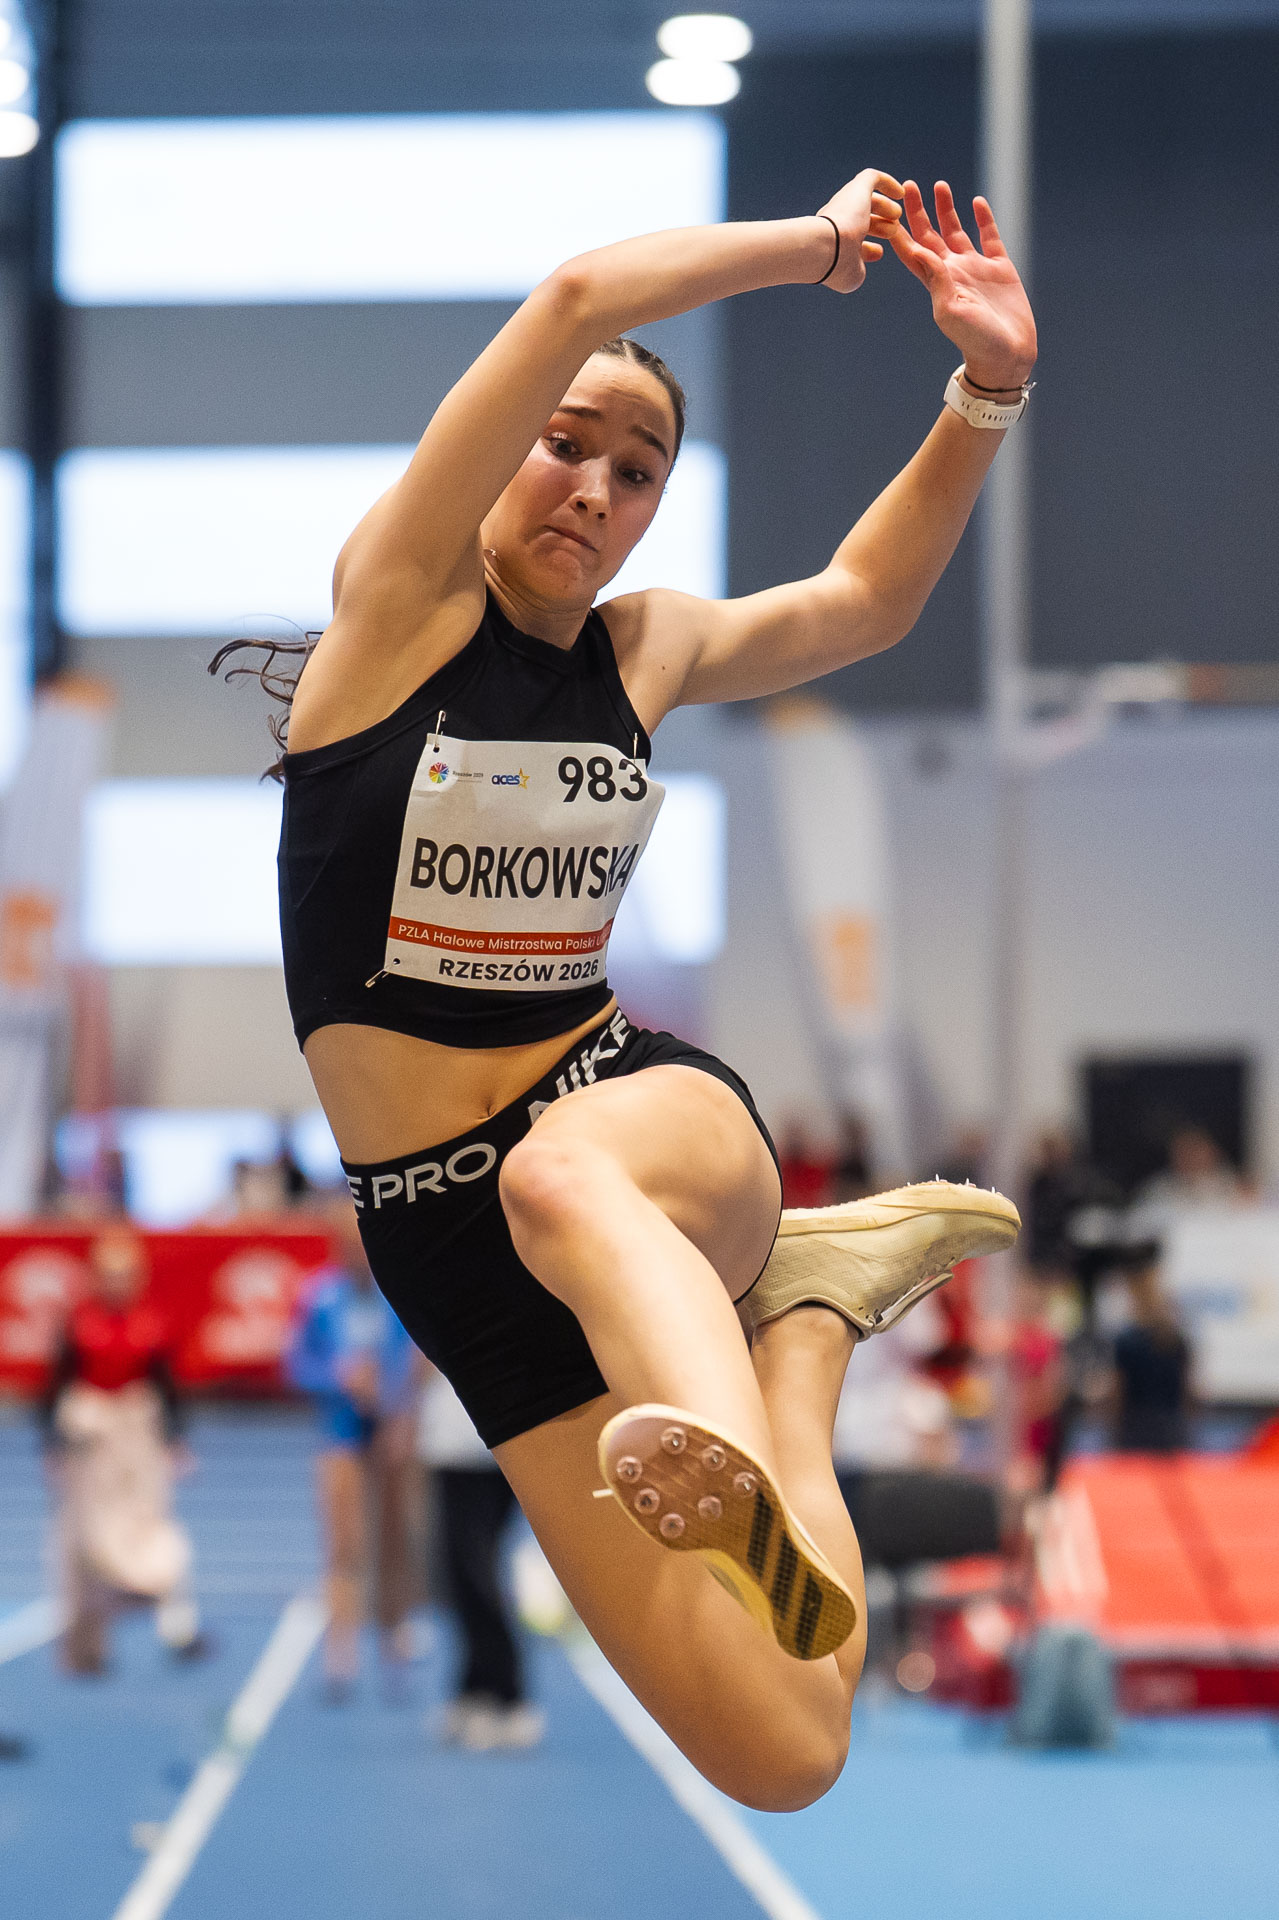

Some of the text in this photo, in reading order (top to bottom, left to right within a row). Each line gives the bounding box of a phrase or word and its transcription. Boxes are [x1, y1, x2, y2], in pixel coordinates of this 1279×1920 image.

[491, 774, 520, 785] aces
[558, 756, 648, 802] 983
[410, 837, 640, 899] BORKOWSKA
[399, 924, 595, 951] PZLA Halowe Mistrzostwa Polski
[439, 958, 599, 982] RZESZÓW 2026
[371, 1142, 497, 1209] PRO
